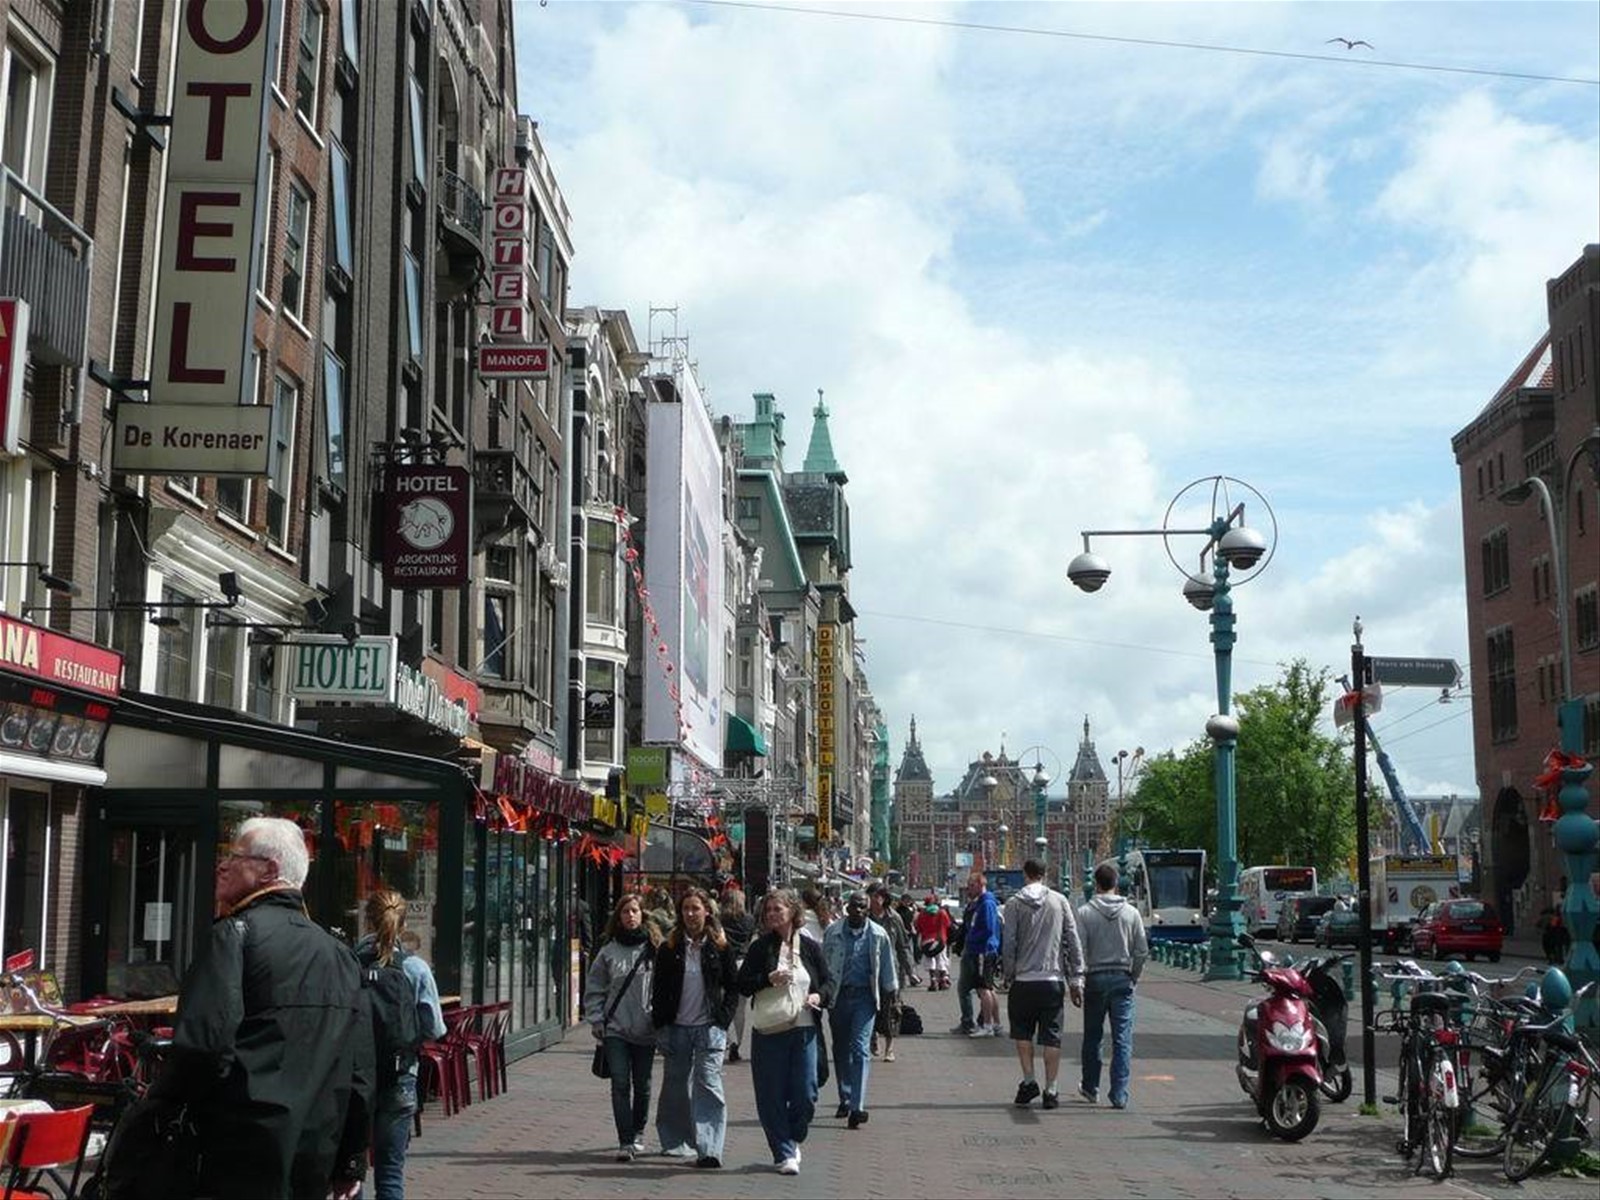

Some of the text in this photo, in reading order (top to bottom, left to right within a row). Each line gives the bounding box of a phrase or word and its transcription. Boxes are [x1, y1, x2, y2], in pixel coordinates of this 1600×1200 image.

[497, 172, 523, 332] HOTEL
[486, 355, 542, 366] MANOFA
[124, 425, 264, 450] De Korenaer
[396, 475, 459, 492] HOTEL
[393, 566, 458, 576] RESTAURANT
[54, 657, 118, 692] RESTAURANT
[295, 645, 385, 690] HOTEL
